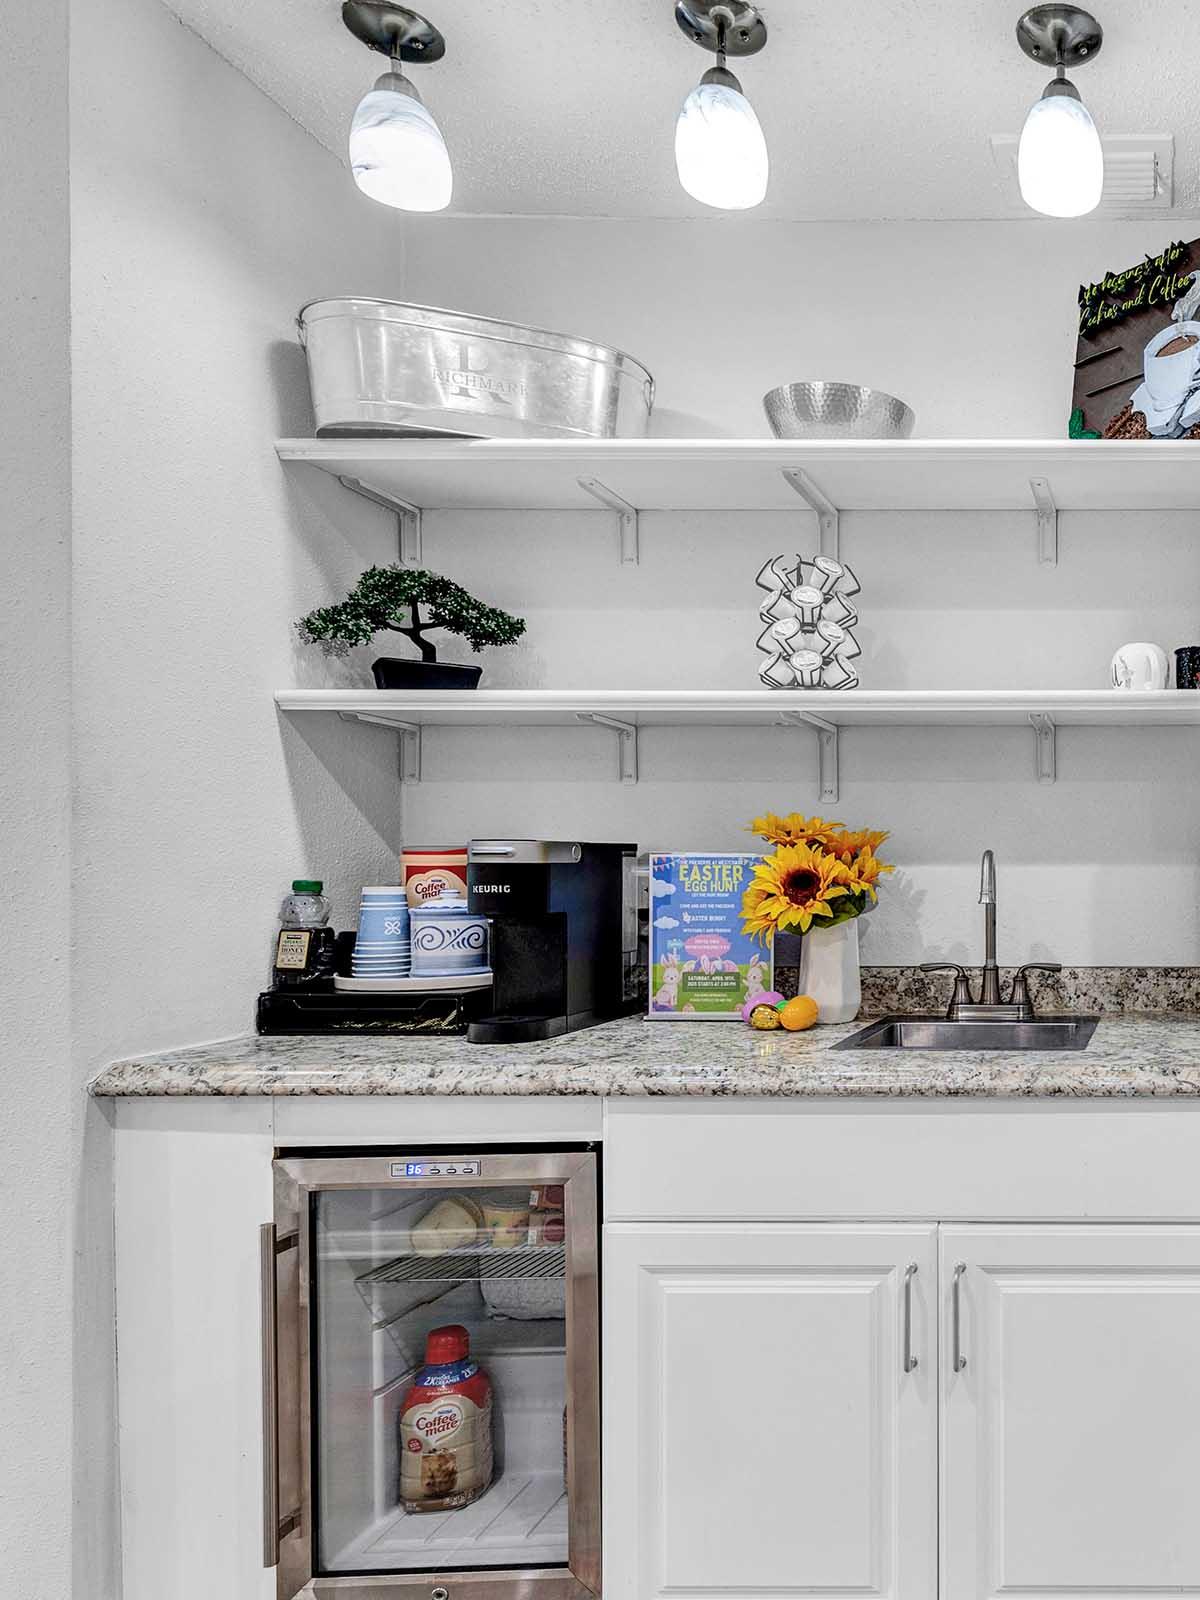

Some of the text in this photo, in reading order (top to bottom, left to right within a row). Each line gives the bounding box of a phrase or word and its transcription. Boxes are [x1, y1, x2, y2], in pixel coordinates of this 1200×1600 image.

[1122, 283, 1145, 311] and
[1148, 273, 1189, 305] Coffee
[679, 864, 743, 881] EASTER
[415, 882, 446, 895] Coffee
[472, 885, 511, 893] KEURIG
[685, 880, 738, 892] EGG HUNT
[421, 888, 449, 899] mat
[408, 1165, 422, 1174] 36
[424, 1376, 437, 1386] 2X
[416, 1413, 457, 1430] Coffee
[425, 1420, 458, 1437] mate
